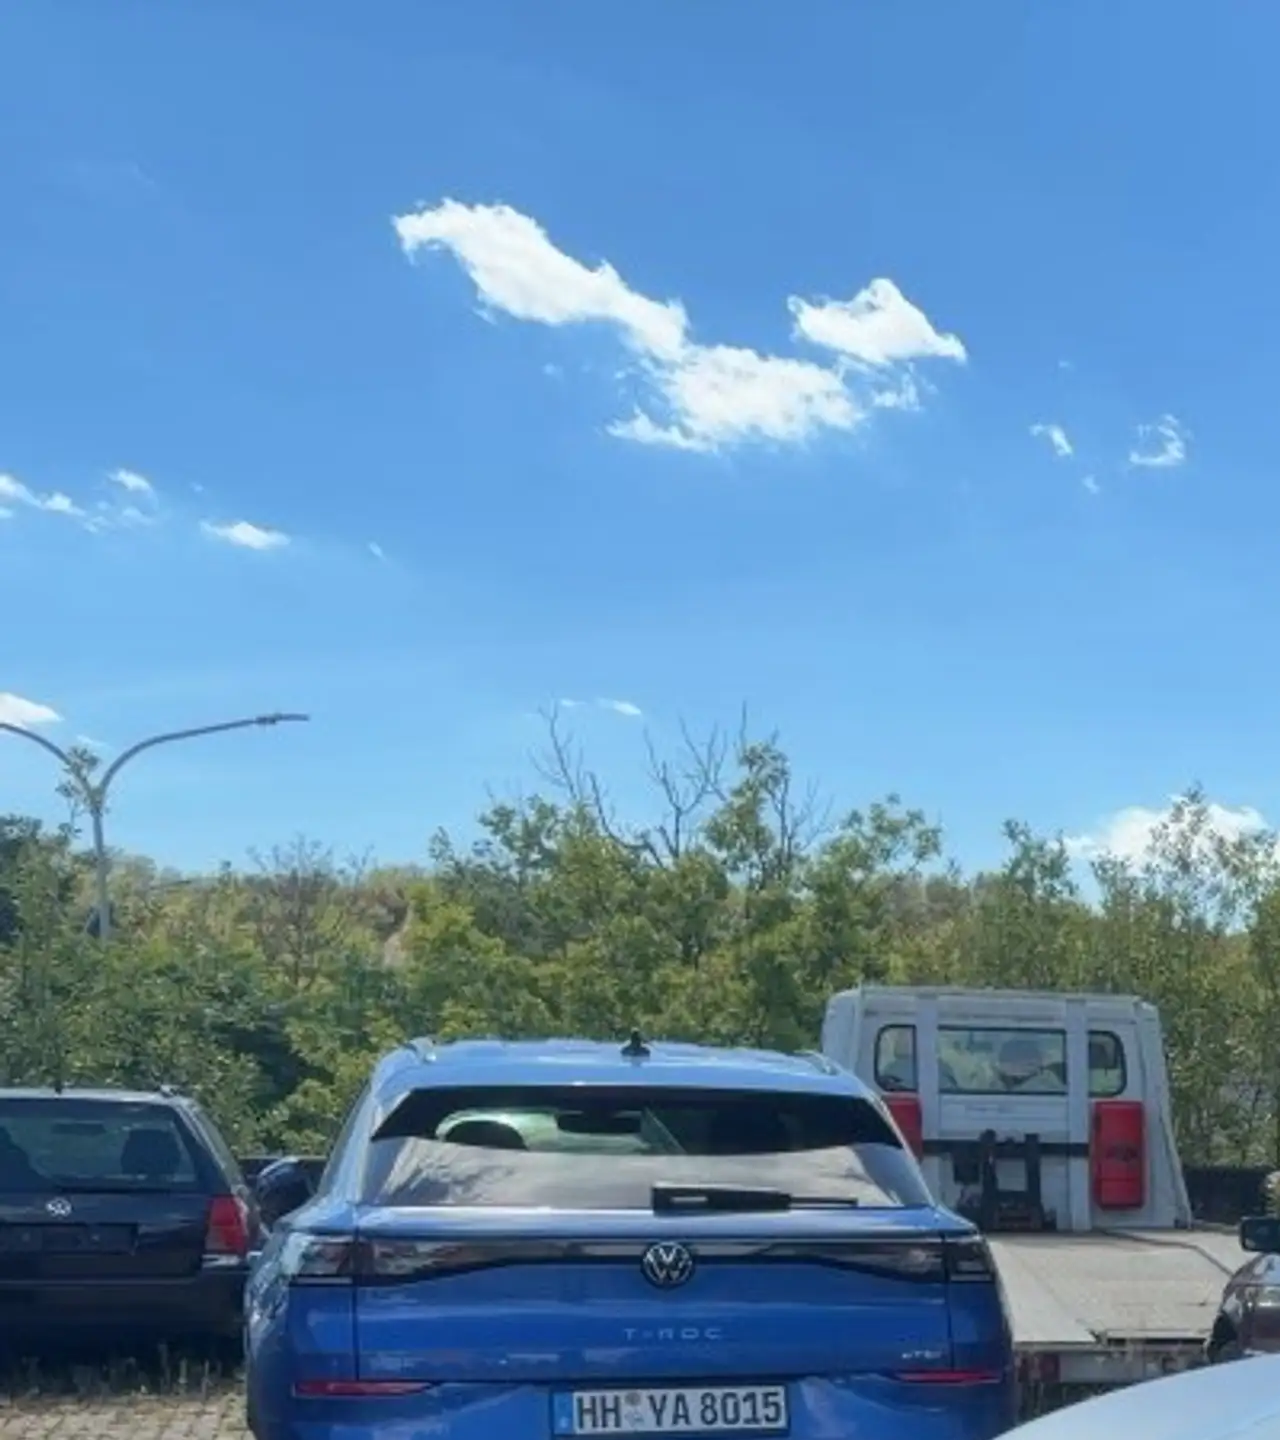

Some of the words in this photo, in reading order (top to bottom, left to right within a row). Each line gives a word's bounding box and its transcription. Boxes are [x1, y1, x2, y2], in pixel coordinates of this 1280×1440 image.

[576, 1396, 622, 1429] HH
[647, 1393, 692, 1427] YA
[700, 1391, 782, 1426] 8015
